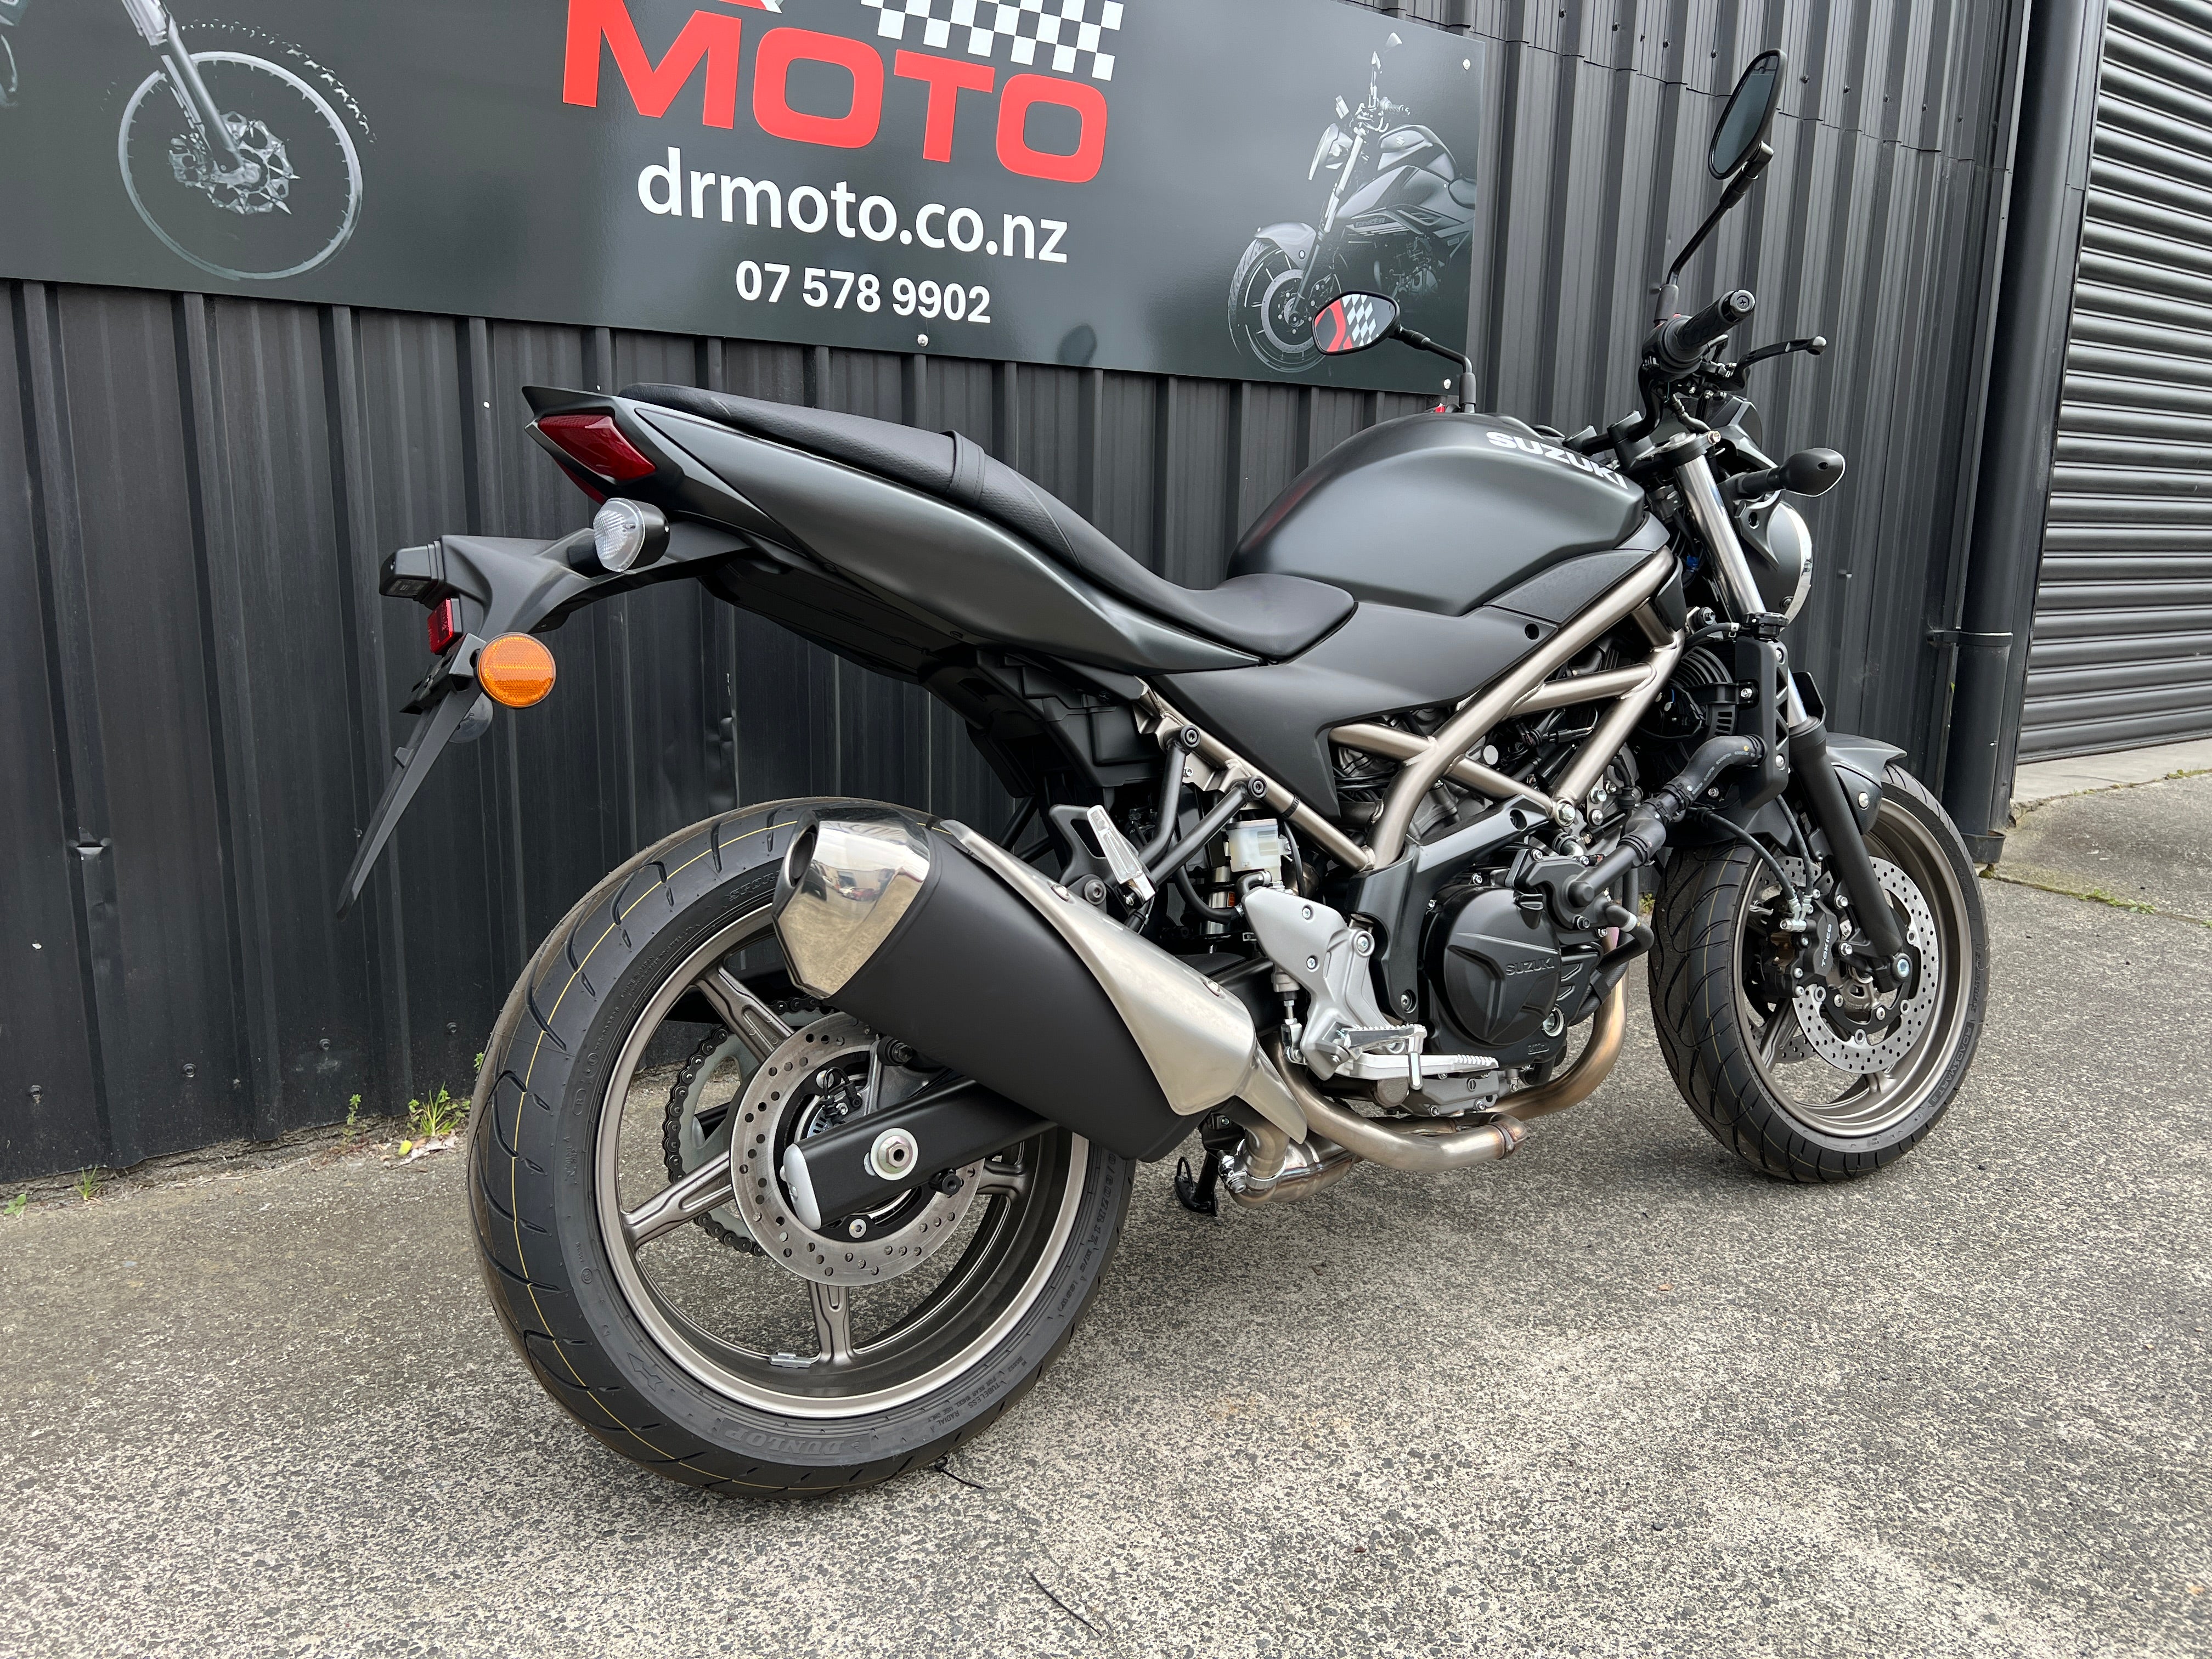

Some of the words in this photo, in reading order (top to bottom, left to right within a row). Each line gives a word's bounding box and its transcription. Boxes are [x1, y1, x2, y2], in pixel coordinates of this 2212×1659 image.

[562, 0, 1108, 183] MOTO
[638, 146, 1068, 263] drmoto.co.nz
[735, 259, 790, 302] 07
[802, 267, 881, 312] 578
[892, 277, 991, 324] 9902
[1486, 431, 1628, 489] SUZUKI
[1821, 923, 1832, 967] TOKICO
[1506, 957, 1555, 976] SUZUKI
[1938, 1027, 1972, 1096] ROADSMART
[972, 1385, 986, 1396] REAR
[988, 1376, 997, 1385] FOR
[968, 1383, 1001, 1409] TUBELESS
[936, 1410, 960, 1426] RADIAL
[943, 1406, 954, 1415] USE
[725, 1429, 844, 1455] DUNLOP
